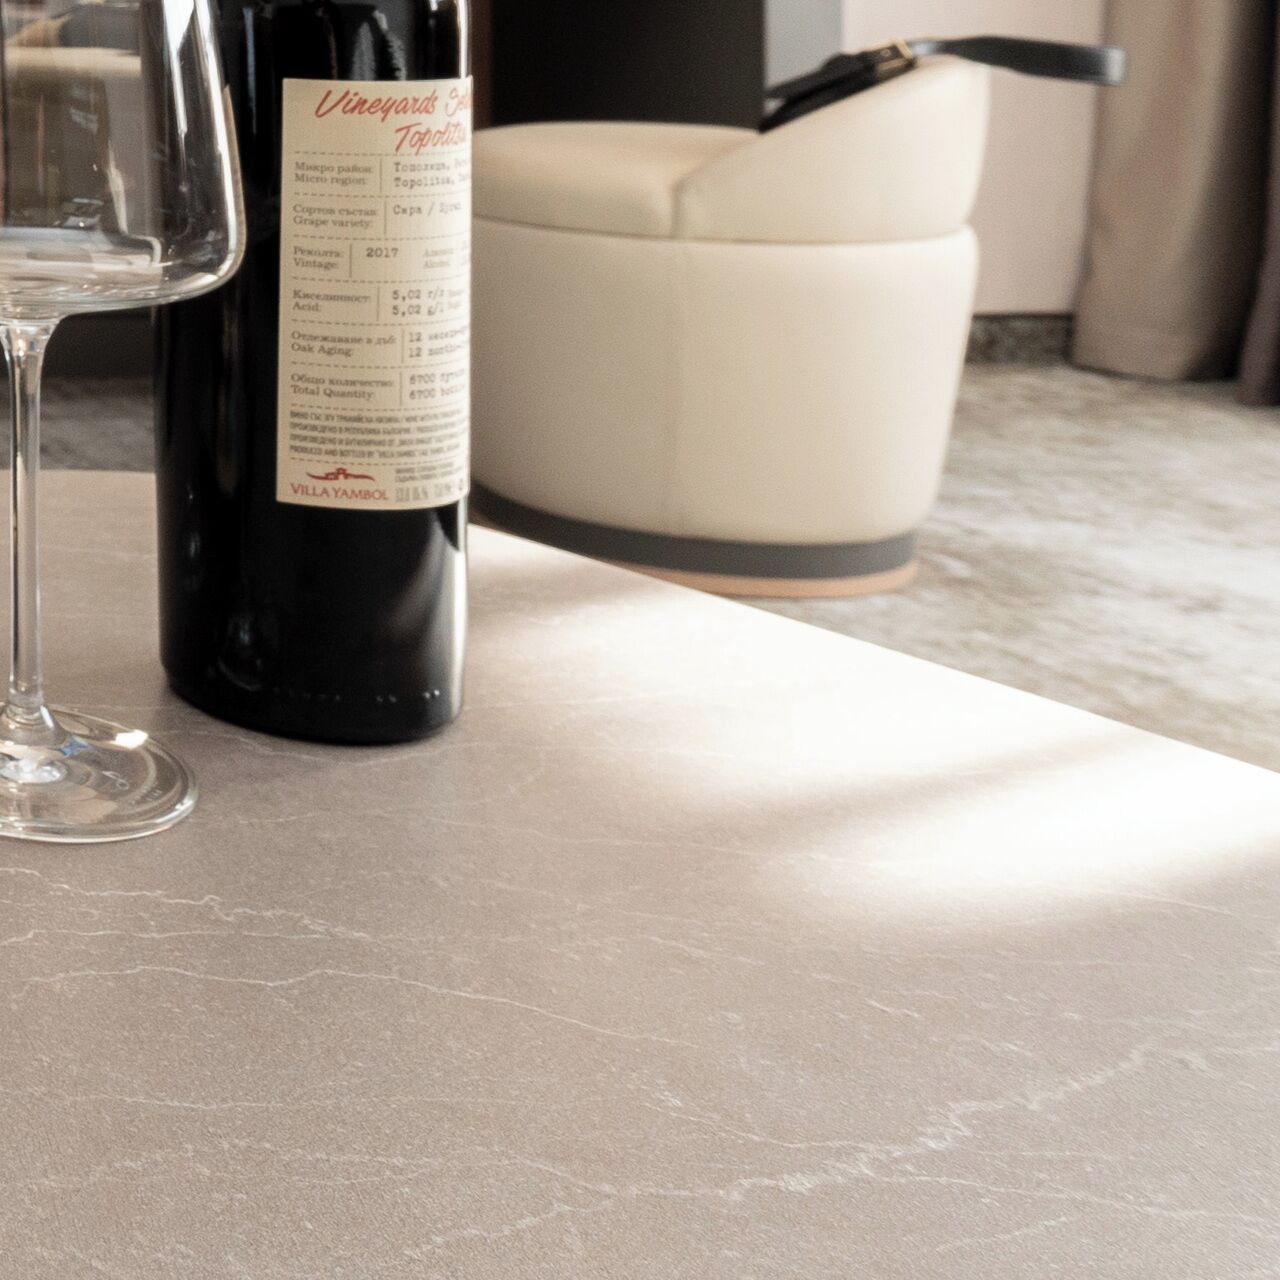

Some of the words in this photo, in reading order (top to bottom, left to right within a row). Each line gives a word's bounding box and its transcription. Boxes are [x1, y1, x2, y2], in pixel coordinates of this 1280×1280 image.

[315, 88, 439, 123] Vineyards
[293, 215, 329, 228] Grape
[365, 247, 399, 258] 2017
[392, 289, 421, 302] 5,02
[392, 304, 421, 317] 5,02
[291, 342, 315, 353] Oak
[291, 385, 320, 396] Total
[290, 482, 330, 497] VILLA
[333, 486, 390, 501] YAMBOL
